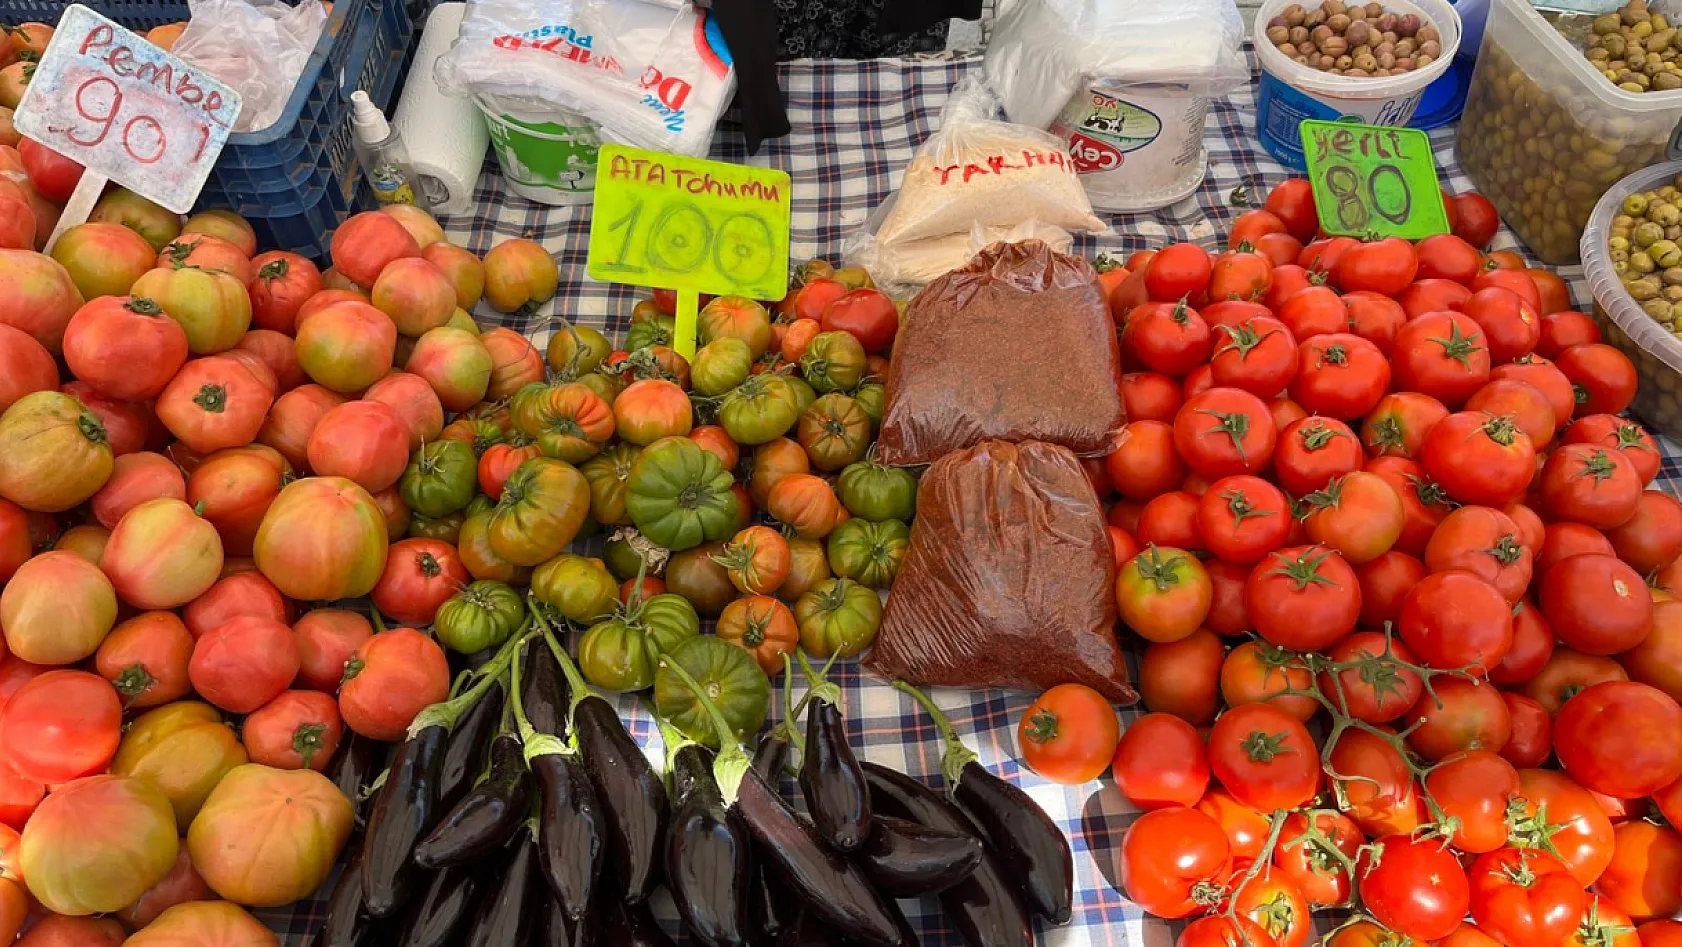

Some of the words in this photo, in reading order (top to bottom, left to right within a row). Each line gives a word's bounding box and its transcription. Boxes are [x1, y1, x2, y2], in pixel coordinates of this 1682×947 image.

[79, 24, 231, 128] Pembe
[610, 154, 667, 186] ATA
[1325, 164, 1412, 231] 80
[593, 202, 776, 287] 100
